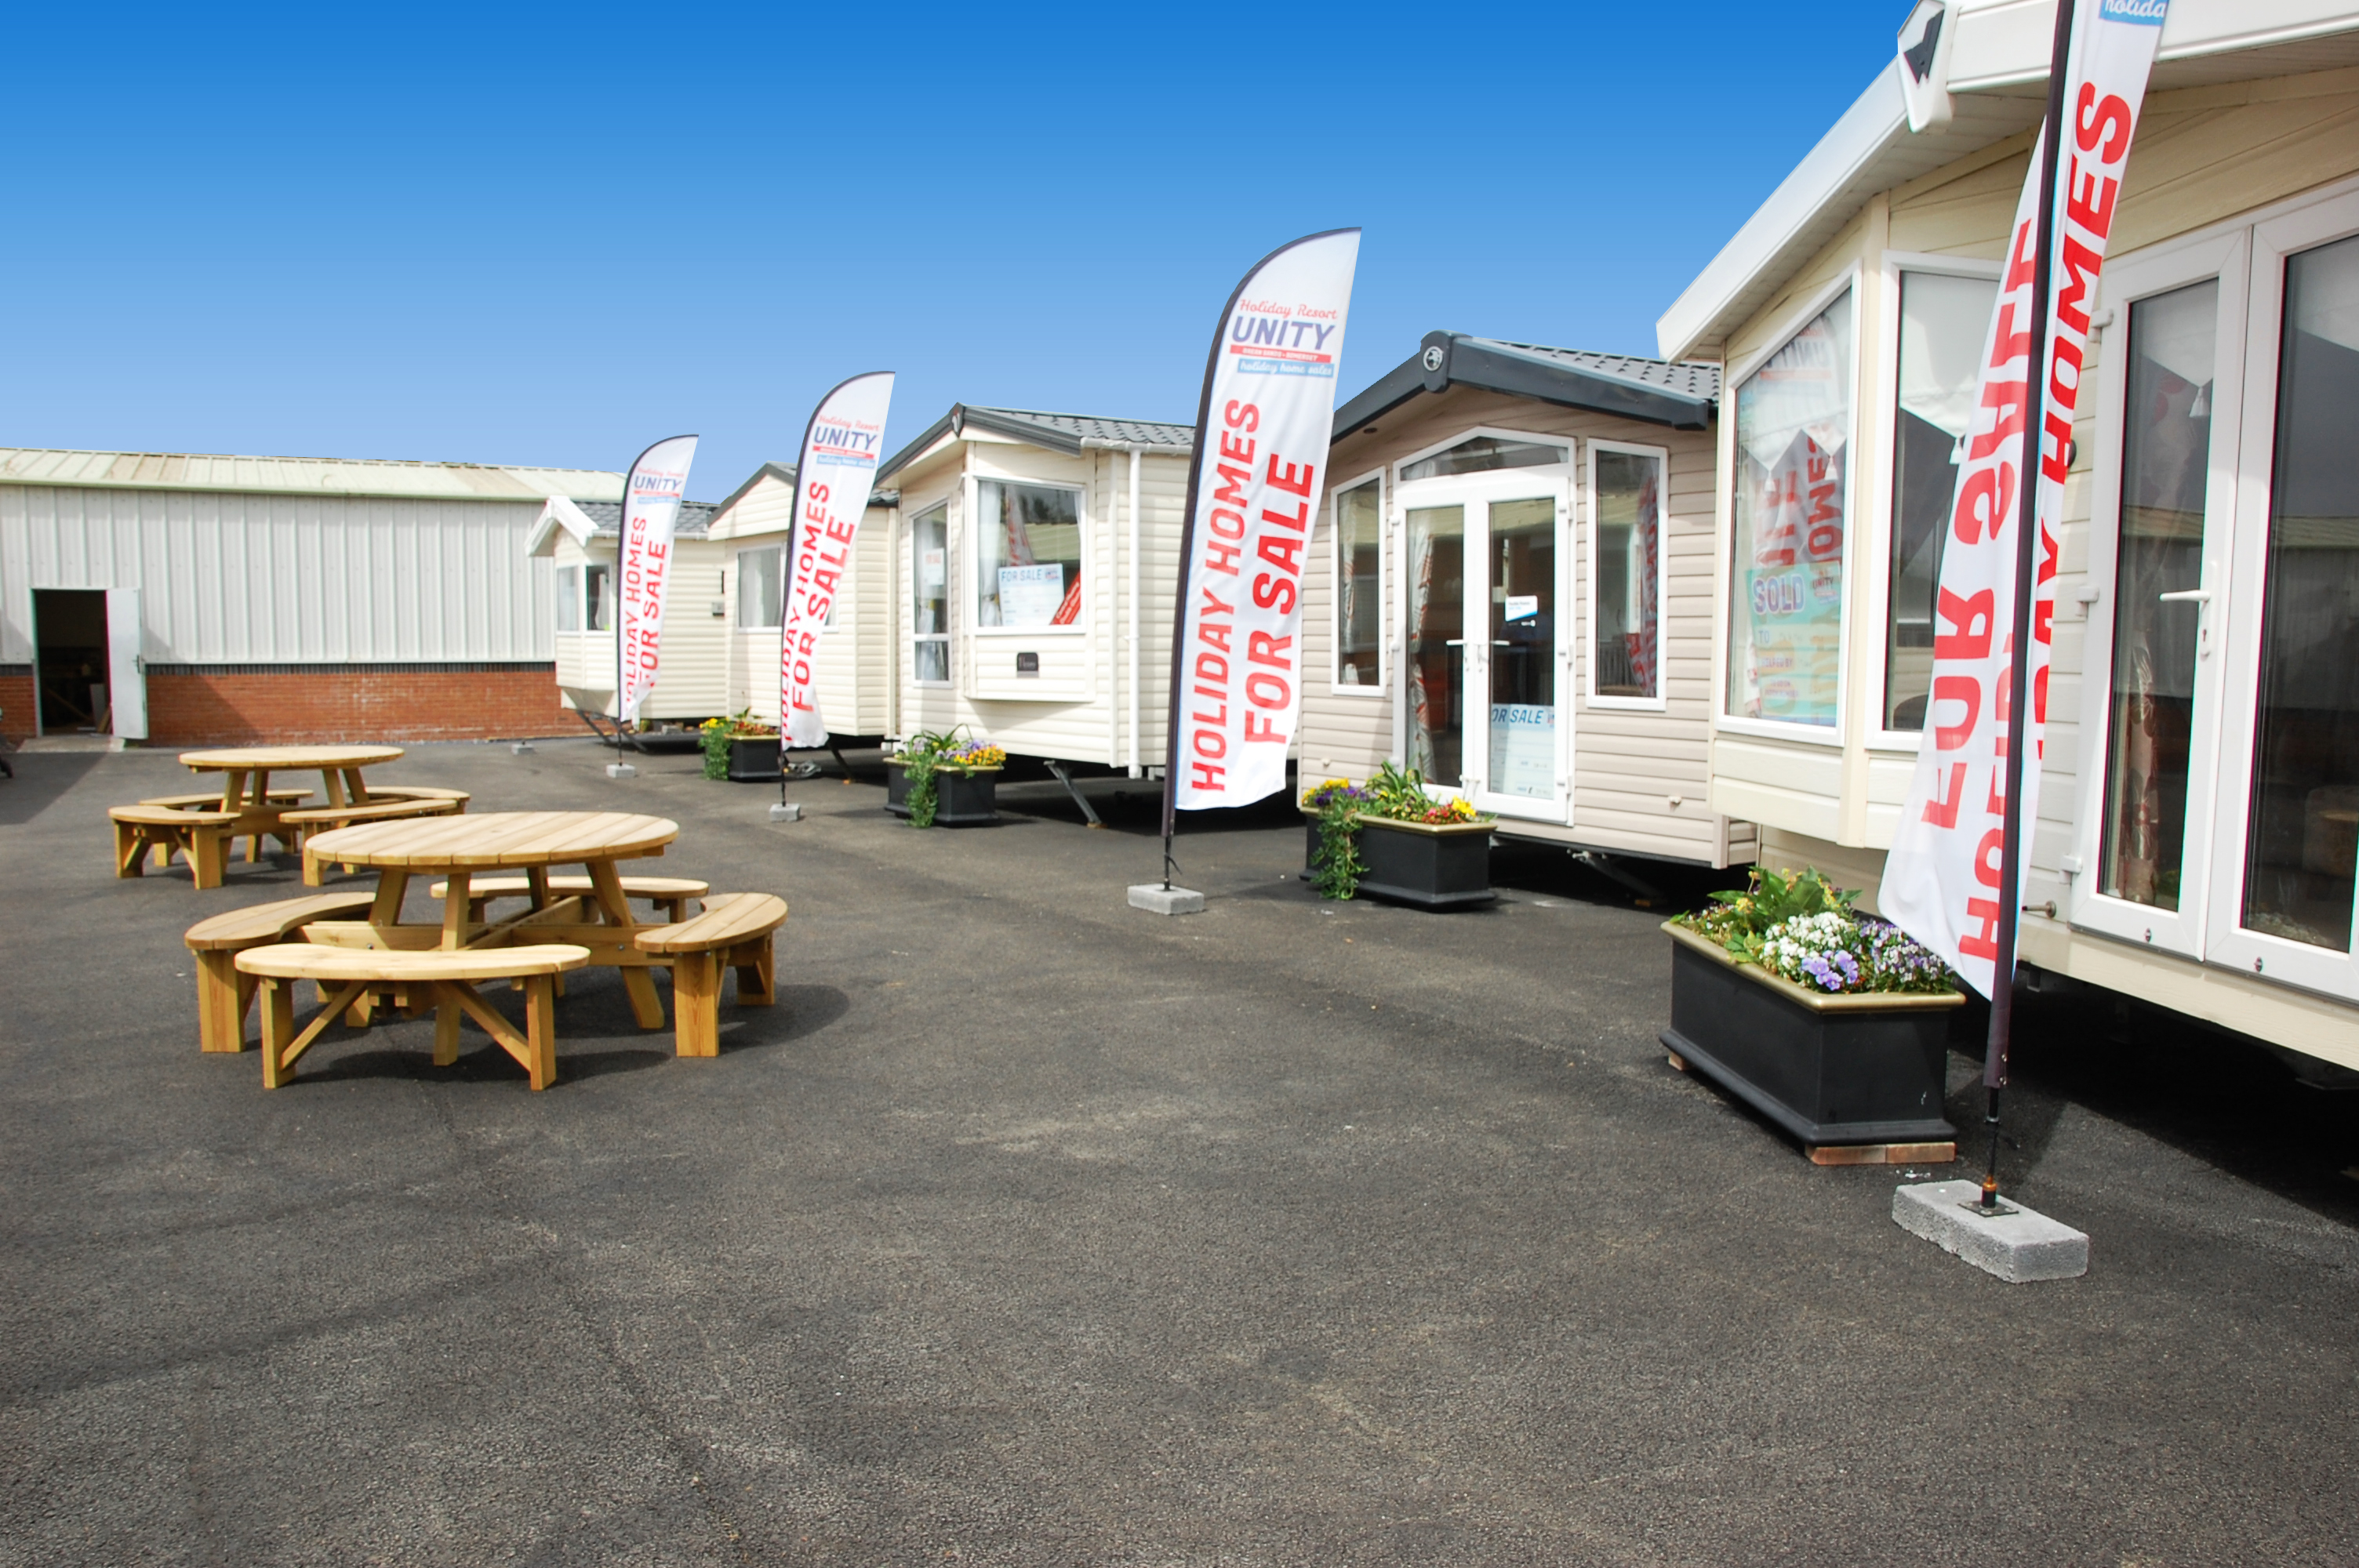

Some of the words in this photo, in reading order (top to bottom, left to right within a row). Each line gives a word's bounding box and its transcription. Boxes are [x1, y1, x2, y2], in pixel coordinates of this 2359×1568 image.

[1240, 299, 1292, 318] Holiday
[1298, 304, 1337, 319] Resort
[2041, 82, 2132, 485] HOMES
[1232, 316, 1336, 350] UNITY
[1240, 361, 1278, 375] holiday
[1280, 363, 1306, 373] home
[1307, 364, 1332, 376] sales
[814, 426, 877, 450] UNITY
[634, 475, 682, 491] UNITY
[1205, 399, 1259, 576] HOMES
[626, 517, 646, 603] HOMES
[796, 481, 830, 597] HOMES
[1252, 453, 1314, 615] SALE
[643, 541, 667, 619] SALE
[792, 632, 817, 712] FOR
[807, 514, 855, 622] SALE
[1001, 571, 1018, 582] FOR
[1020, 568, 1042, 581] SALE
[1753, 576, 1805, 614] SOLD
[626, 611, 638, 702] OLIDAY
[1758, 630, 1770, 644] TO
[1191, 587, 1234, 792] HOLIDAY
[1245, 630, 1292, 744] FOR
[1510, 709, 1544, 724] SALE
